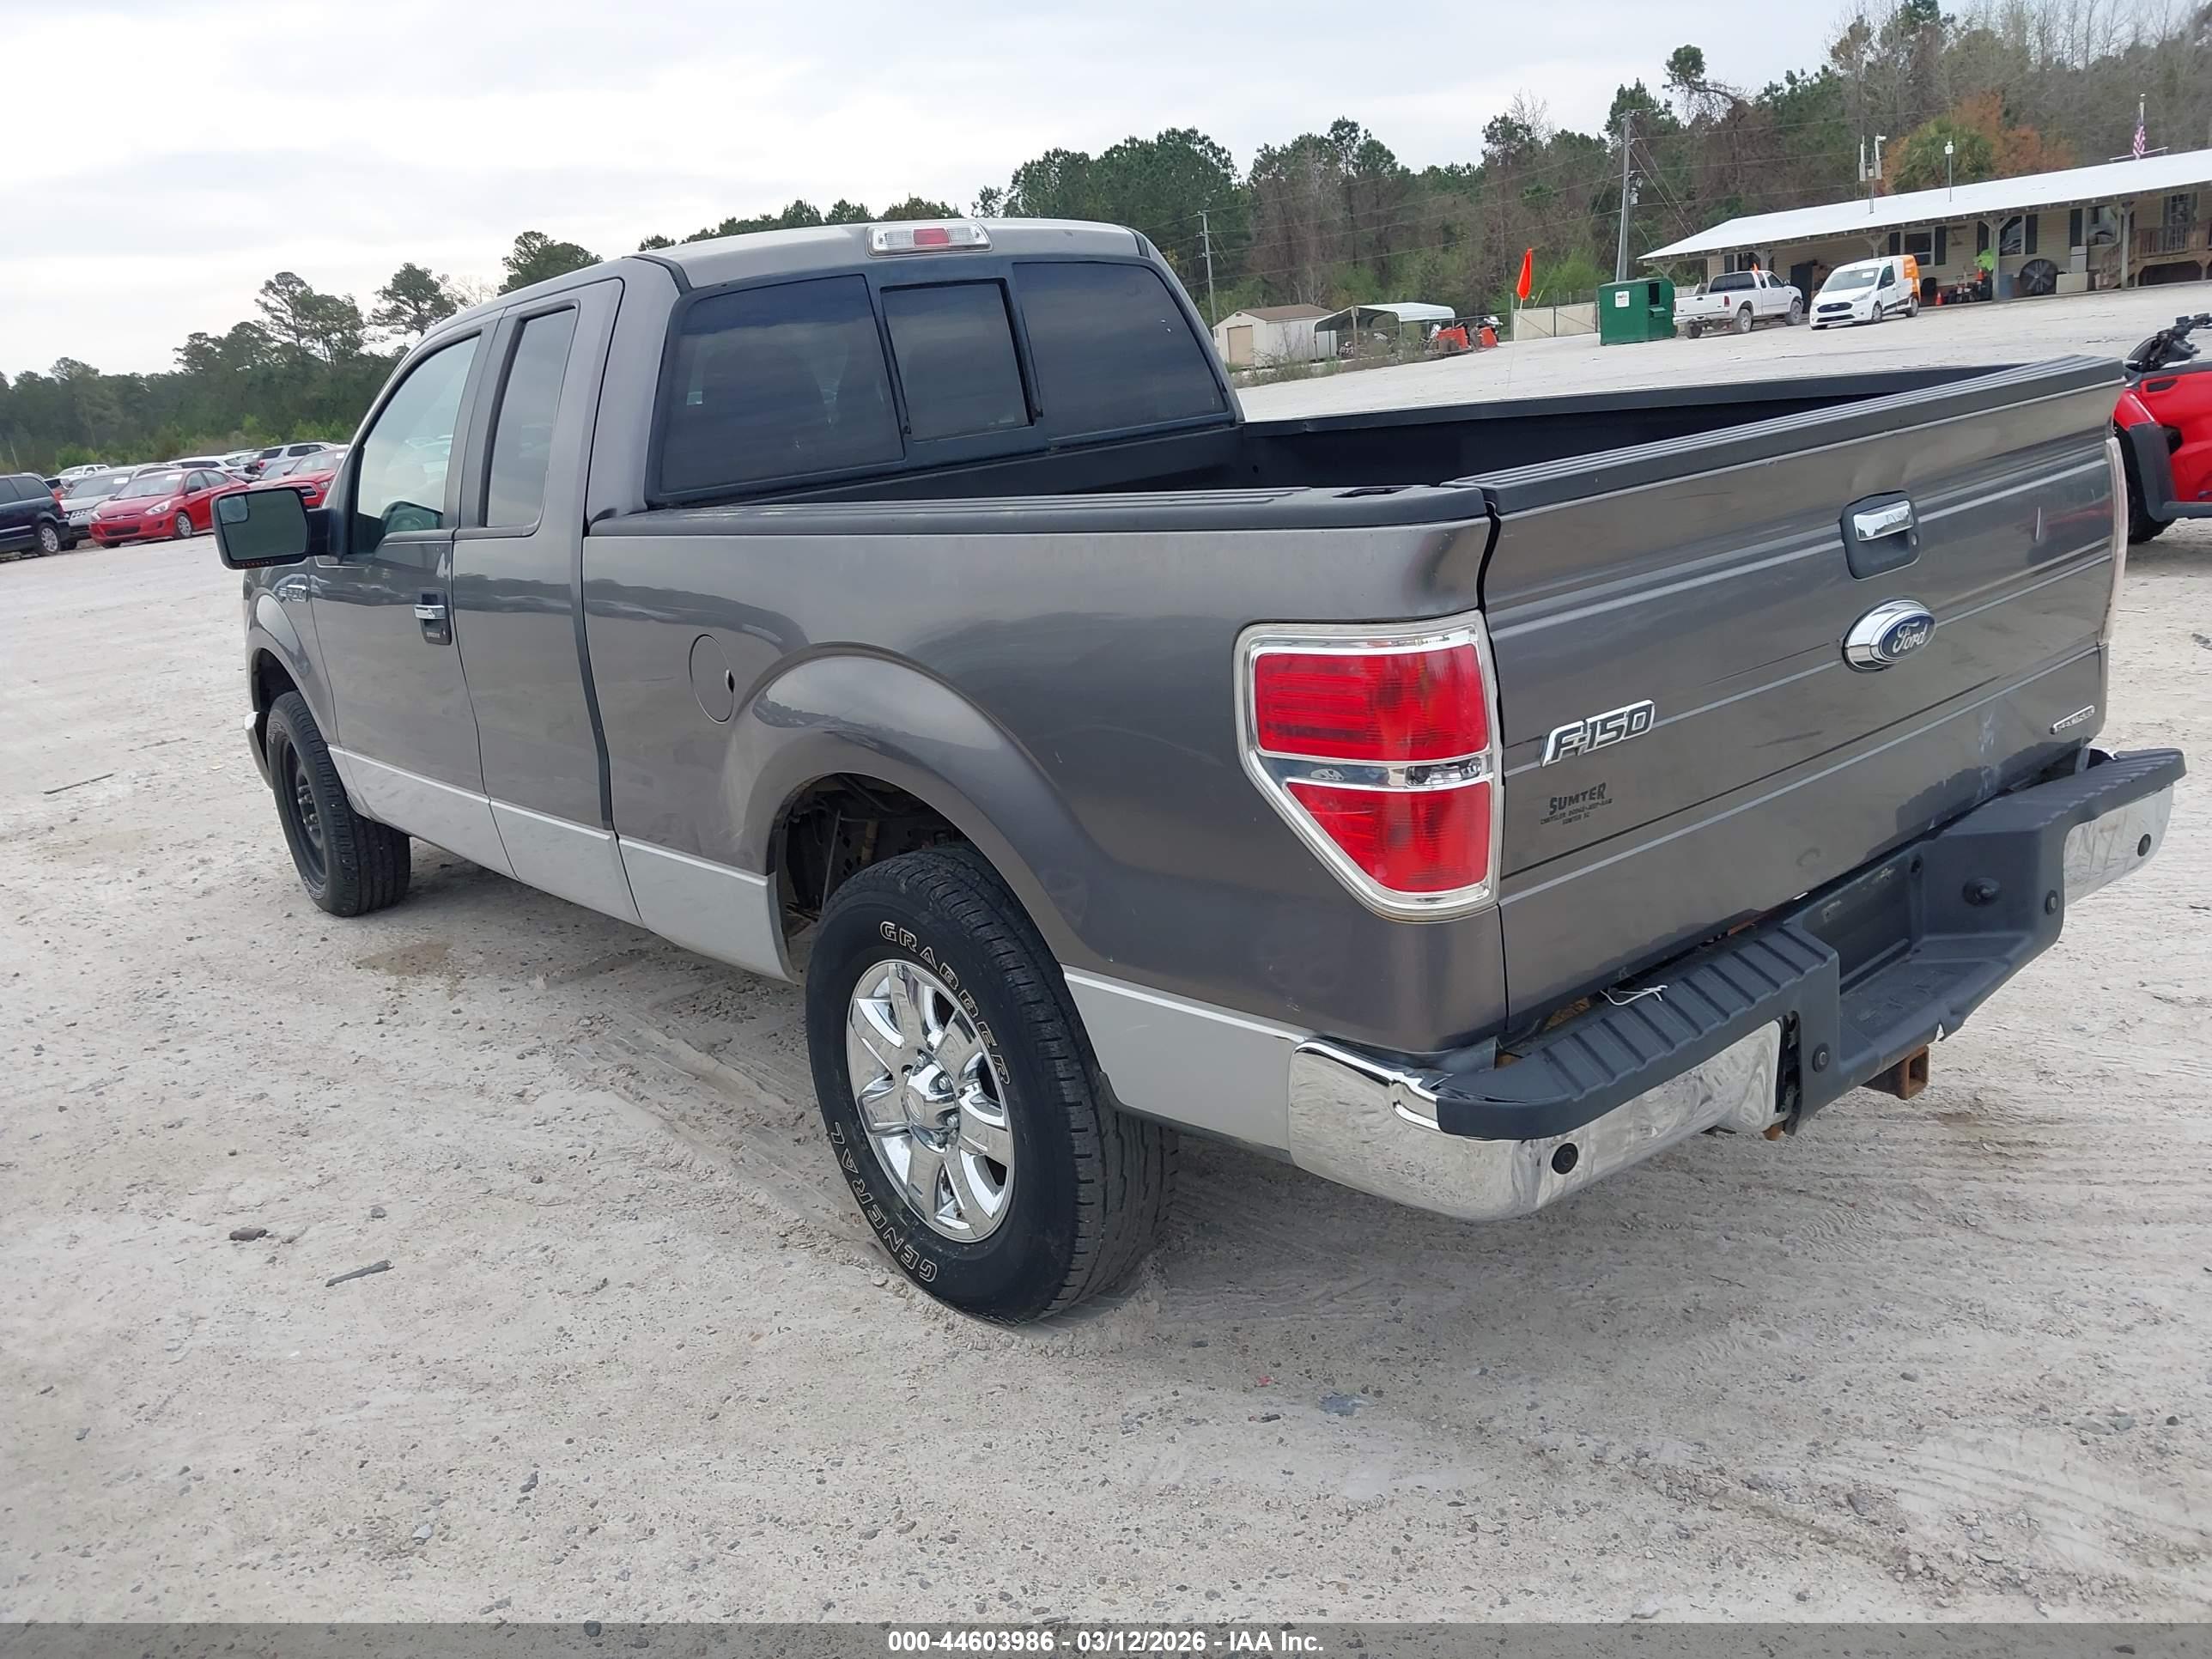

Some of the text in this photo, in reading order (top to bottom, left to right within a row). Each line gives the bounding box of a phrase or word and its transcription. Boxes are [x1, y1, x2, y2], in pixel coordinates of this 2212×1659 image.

[1892, 620, 1928, 653] Ford
[1549, 781, 1607, 816] SUMTER
[879, 921, 1011, 1085] GRABBER
[830, 1121, 938, 1283] GENERAL
